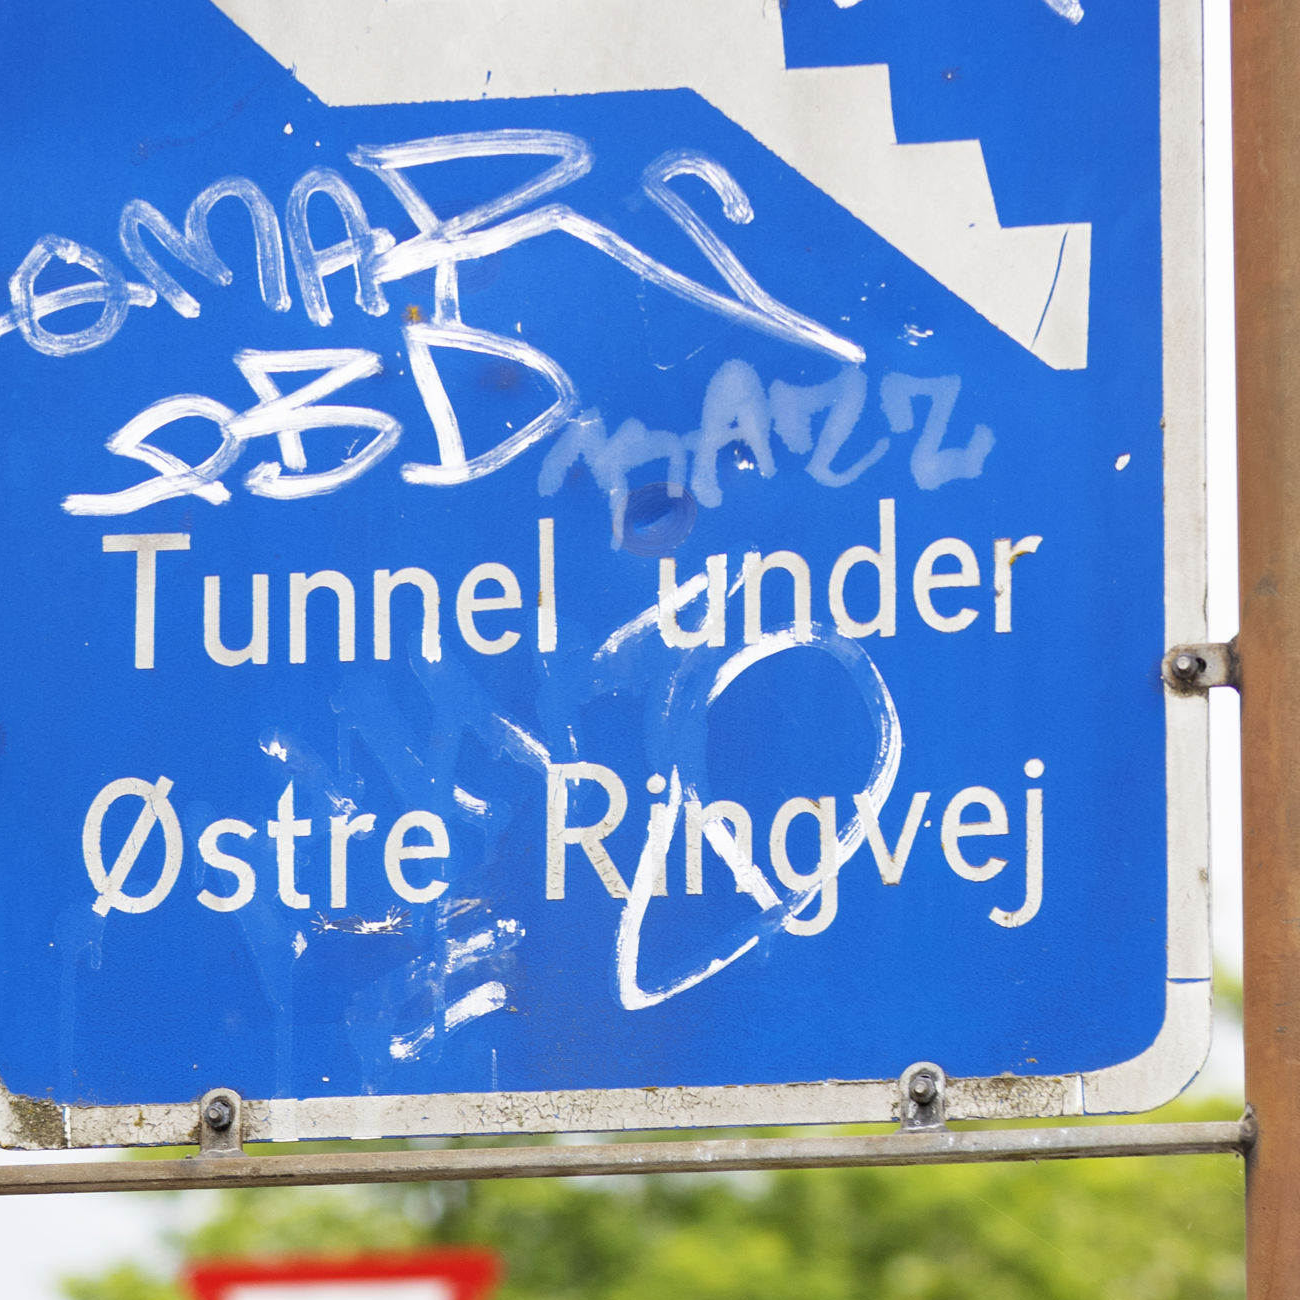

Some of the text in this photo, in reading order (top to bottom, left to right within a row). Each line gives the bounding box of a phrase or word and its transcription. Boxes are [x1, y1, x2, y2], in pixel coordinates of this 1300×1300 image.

[103, 499, 1043, 670] Tunnel under
[82, 758, 1044, 936] Østre Ringvej
